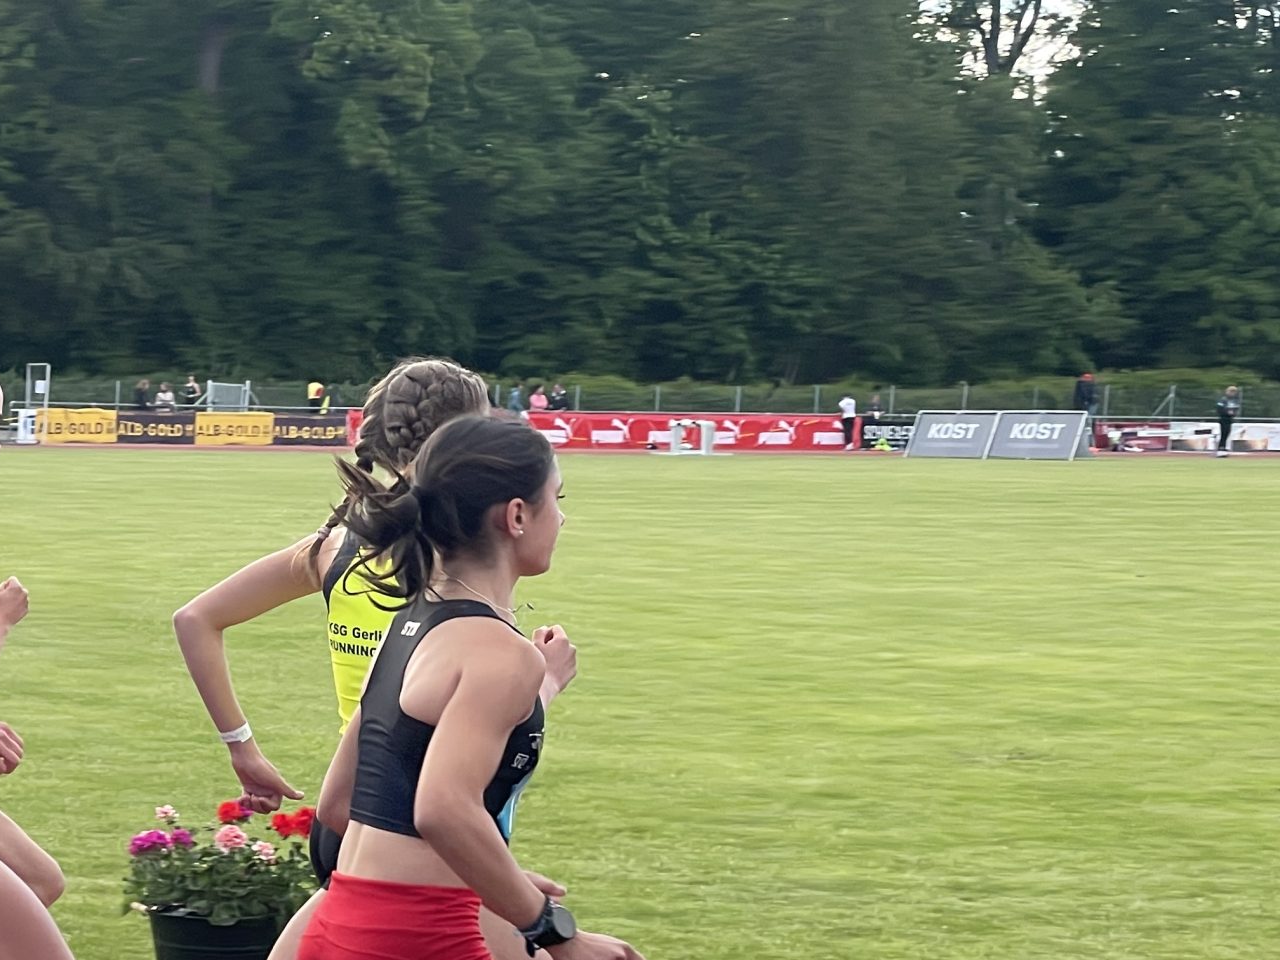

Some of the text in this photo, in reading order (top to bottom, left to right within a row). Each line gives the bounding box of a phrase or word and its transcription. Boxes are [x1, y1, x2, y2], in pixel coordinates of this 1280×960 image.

[927, 423, 980, 439] KOST
[1009, 423, 1067, 440] KOST
[352, 627, 382, 642] Gerli
